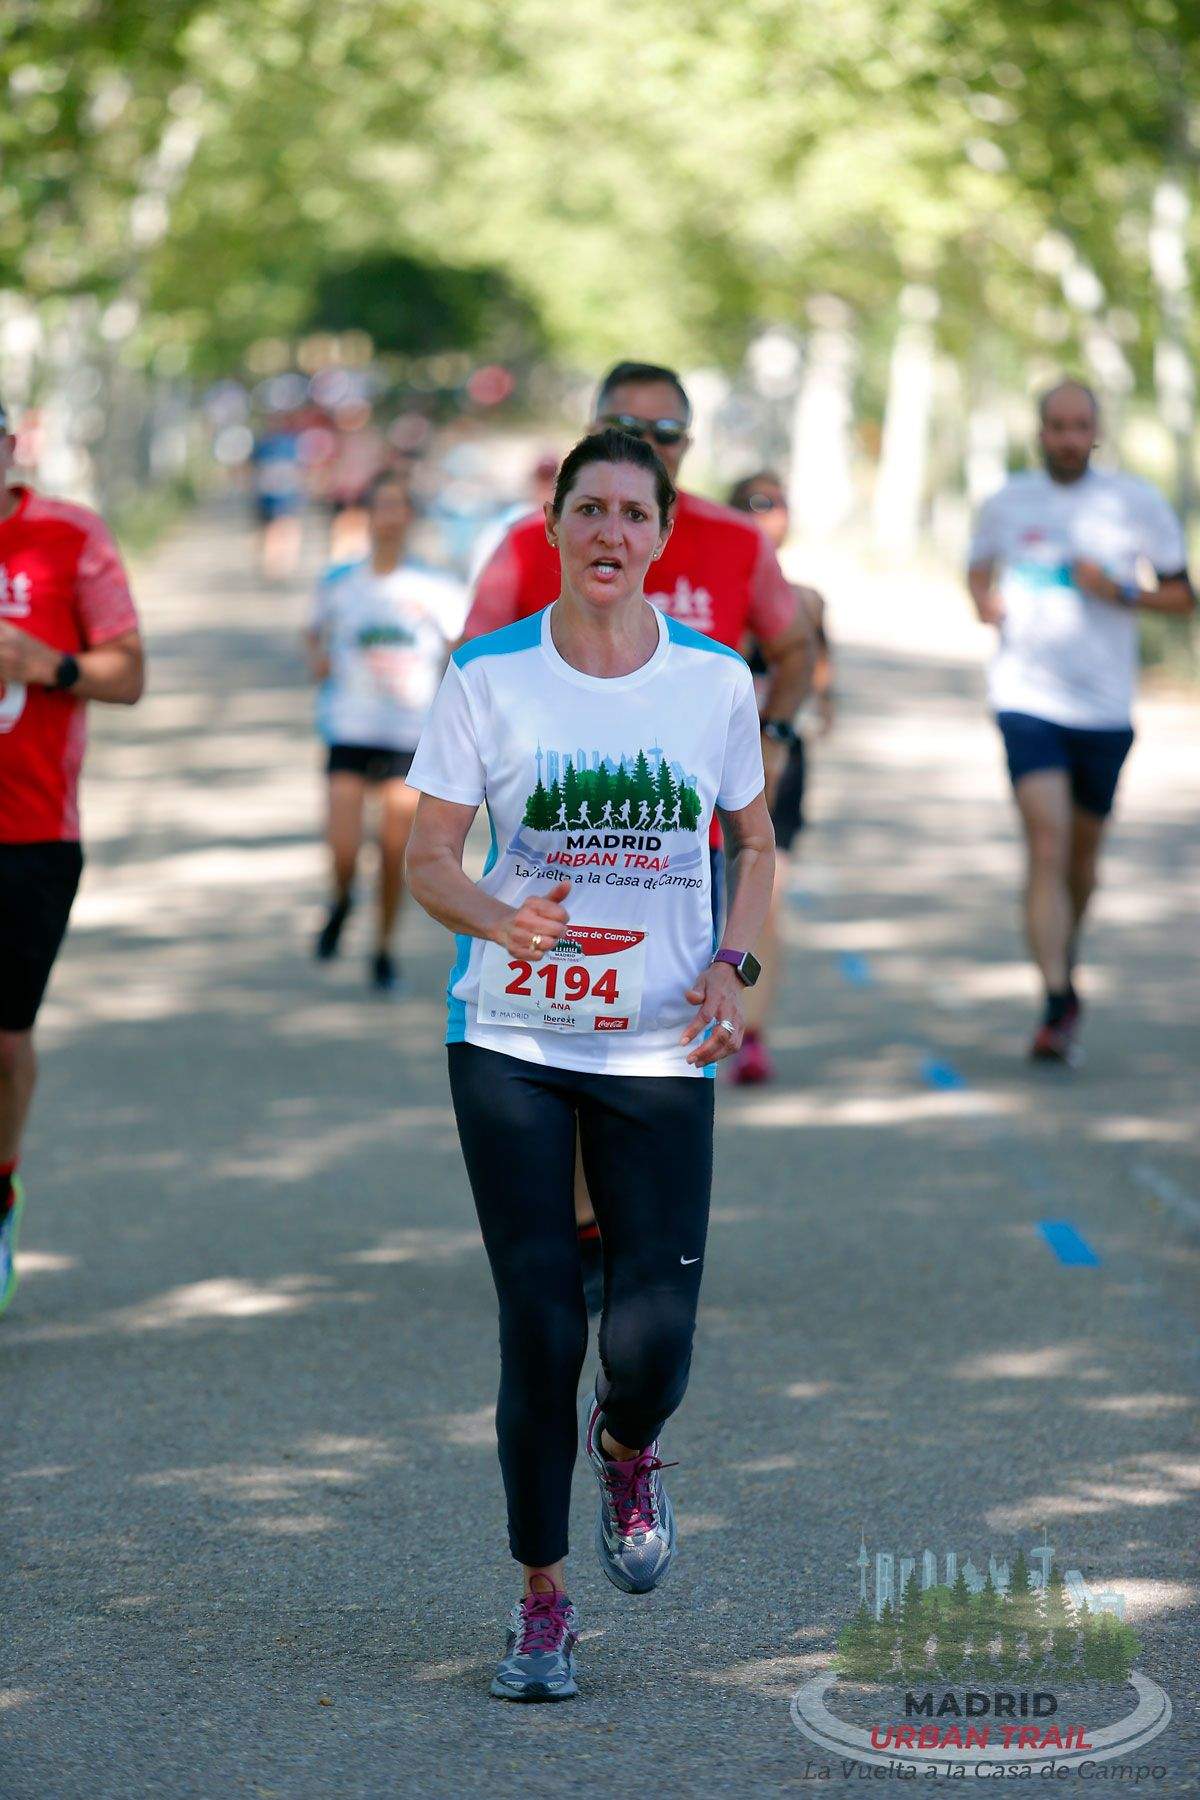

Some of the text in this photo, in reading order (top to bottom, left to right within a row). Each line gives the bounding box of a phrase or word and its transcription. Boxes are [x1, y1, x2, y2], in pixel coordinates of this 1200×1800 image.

[566, 834, 662, 852] MADRID
[546, 851, 618, 868] URBAN
[515, 864, 530, 878] La
[574, 874, 584, 884] a
[588, 872, 601, 884] la
[605, 872, 640, 887] Casa
[659, 873, 703, 889] Campo
[566, 929, 637, 943] Casa de Campo
[505, 959, 620, 1005] 2194
[550, 1002, 571, 1011] ANA
[499, 1011, 529, 1020] MADRID
